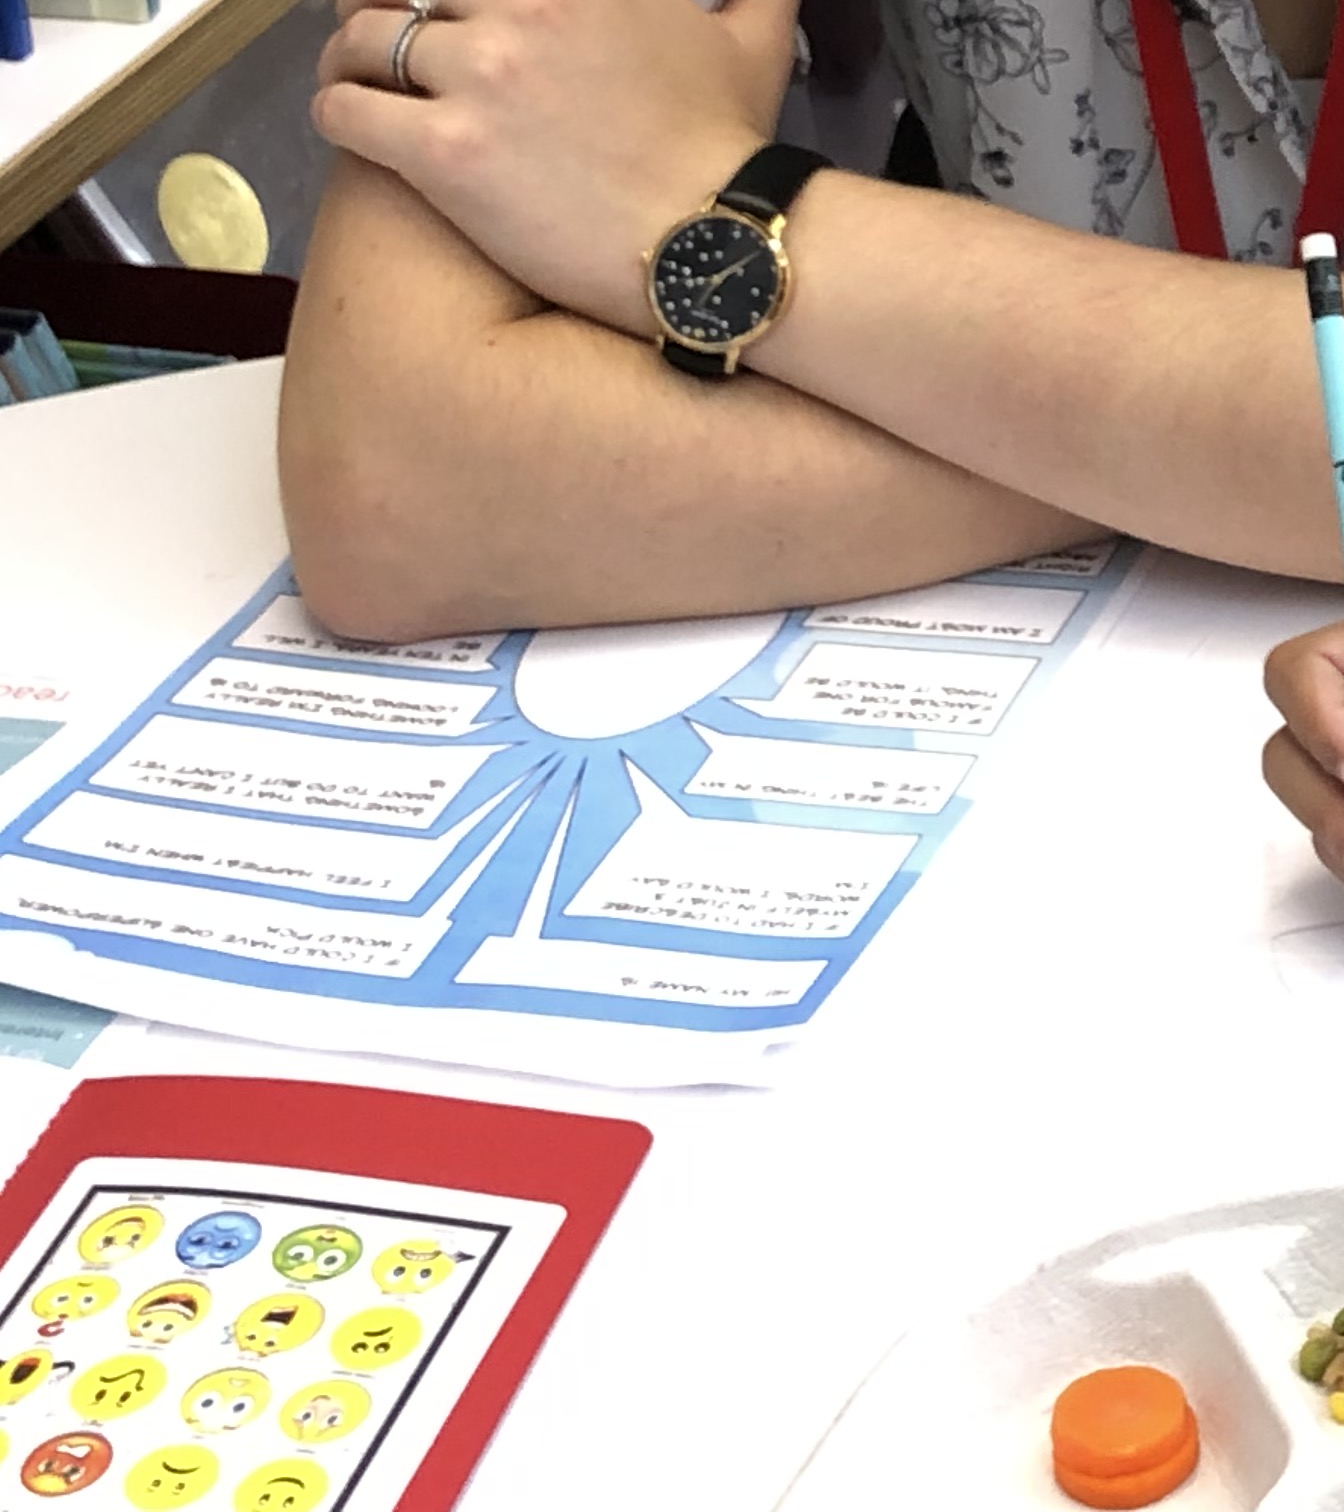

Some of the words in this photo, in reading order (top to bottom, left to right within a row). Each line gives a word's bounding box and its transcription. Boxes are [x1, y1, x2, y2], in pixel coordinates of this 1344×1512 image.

[232, 680, 259, 692] TO
[203, 692, 284, 709] REALLY
[265, 686, 366, 705] FORWARD
[812, 691, 853, 702] ONE
[860, 694, 900, 706] FOR
[371, 697, 460, 714] LOOKING
[909, 699, 993, 712] FAMOUS
[331, 706, 448, 727] SOMETHING
[306, 782, 339, 794] DO
[342, 785, 369, 796] TO
[241, 789, 294, 803] THAT
[304, 796, 425, 817] SOMETHING
[325, 873, 373, 887] FEEL
[17, 897, 163, 930] SUPERPOWER
[171, 923, 214, 938] ONE
[221, 933, 277, 951] HAVE
[317, 933, 393, 948] WOULD
[283, 947, 356, 962] COULD
[648, 980, 710, 995] NAME
